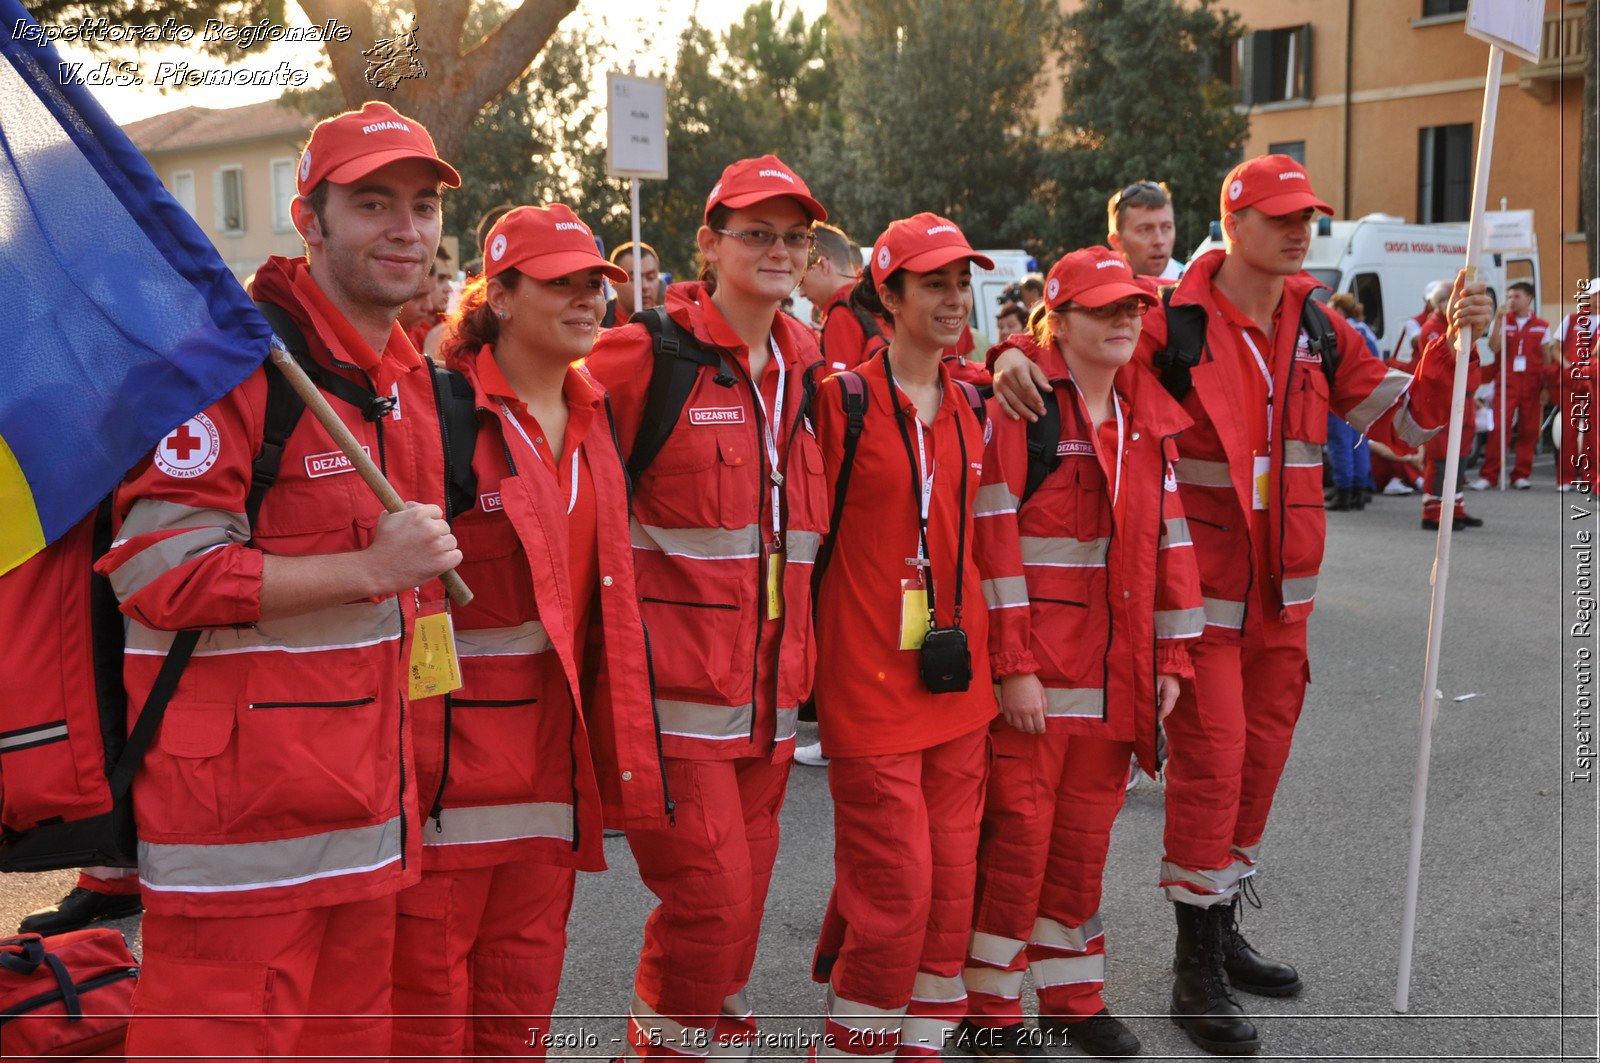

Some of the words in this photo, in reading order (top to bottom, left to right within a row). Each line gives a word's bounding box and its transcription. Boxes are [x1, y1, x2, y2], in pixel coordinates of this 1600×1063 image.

[362, 121, 411, 135] ROMANIA
[759, 169, 794, 184] ROMANIA
[1279, 171, 1305, 181] ROMANIA
[555, 221, 589, 236] ROMANIA
[927, 225, 957, 236] ROMANIA
[1096, 259, 1125, 270] ROMANIA
[694, 411, 739, 420] DEZASTRE
[1056, 443, 1093, 452] DEZASTRE
[312, 456, 352, 471] DEZAS
[166, 467, 204, 477] ROMANIA
